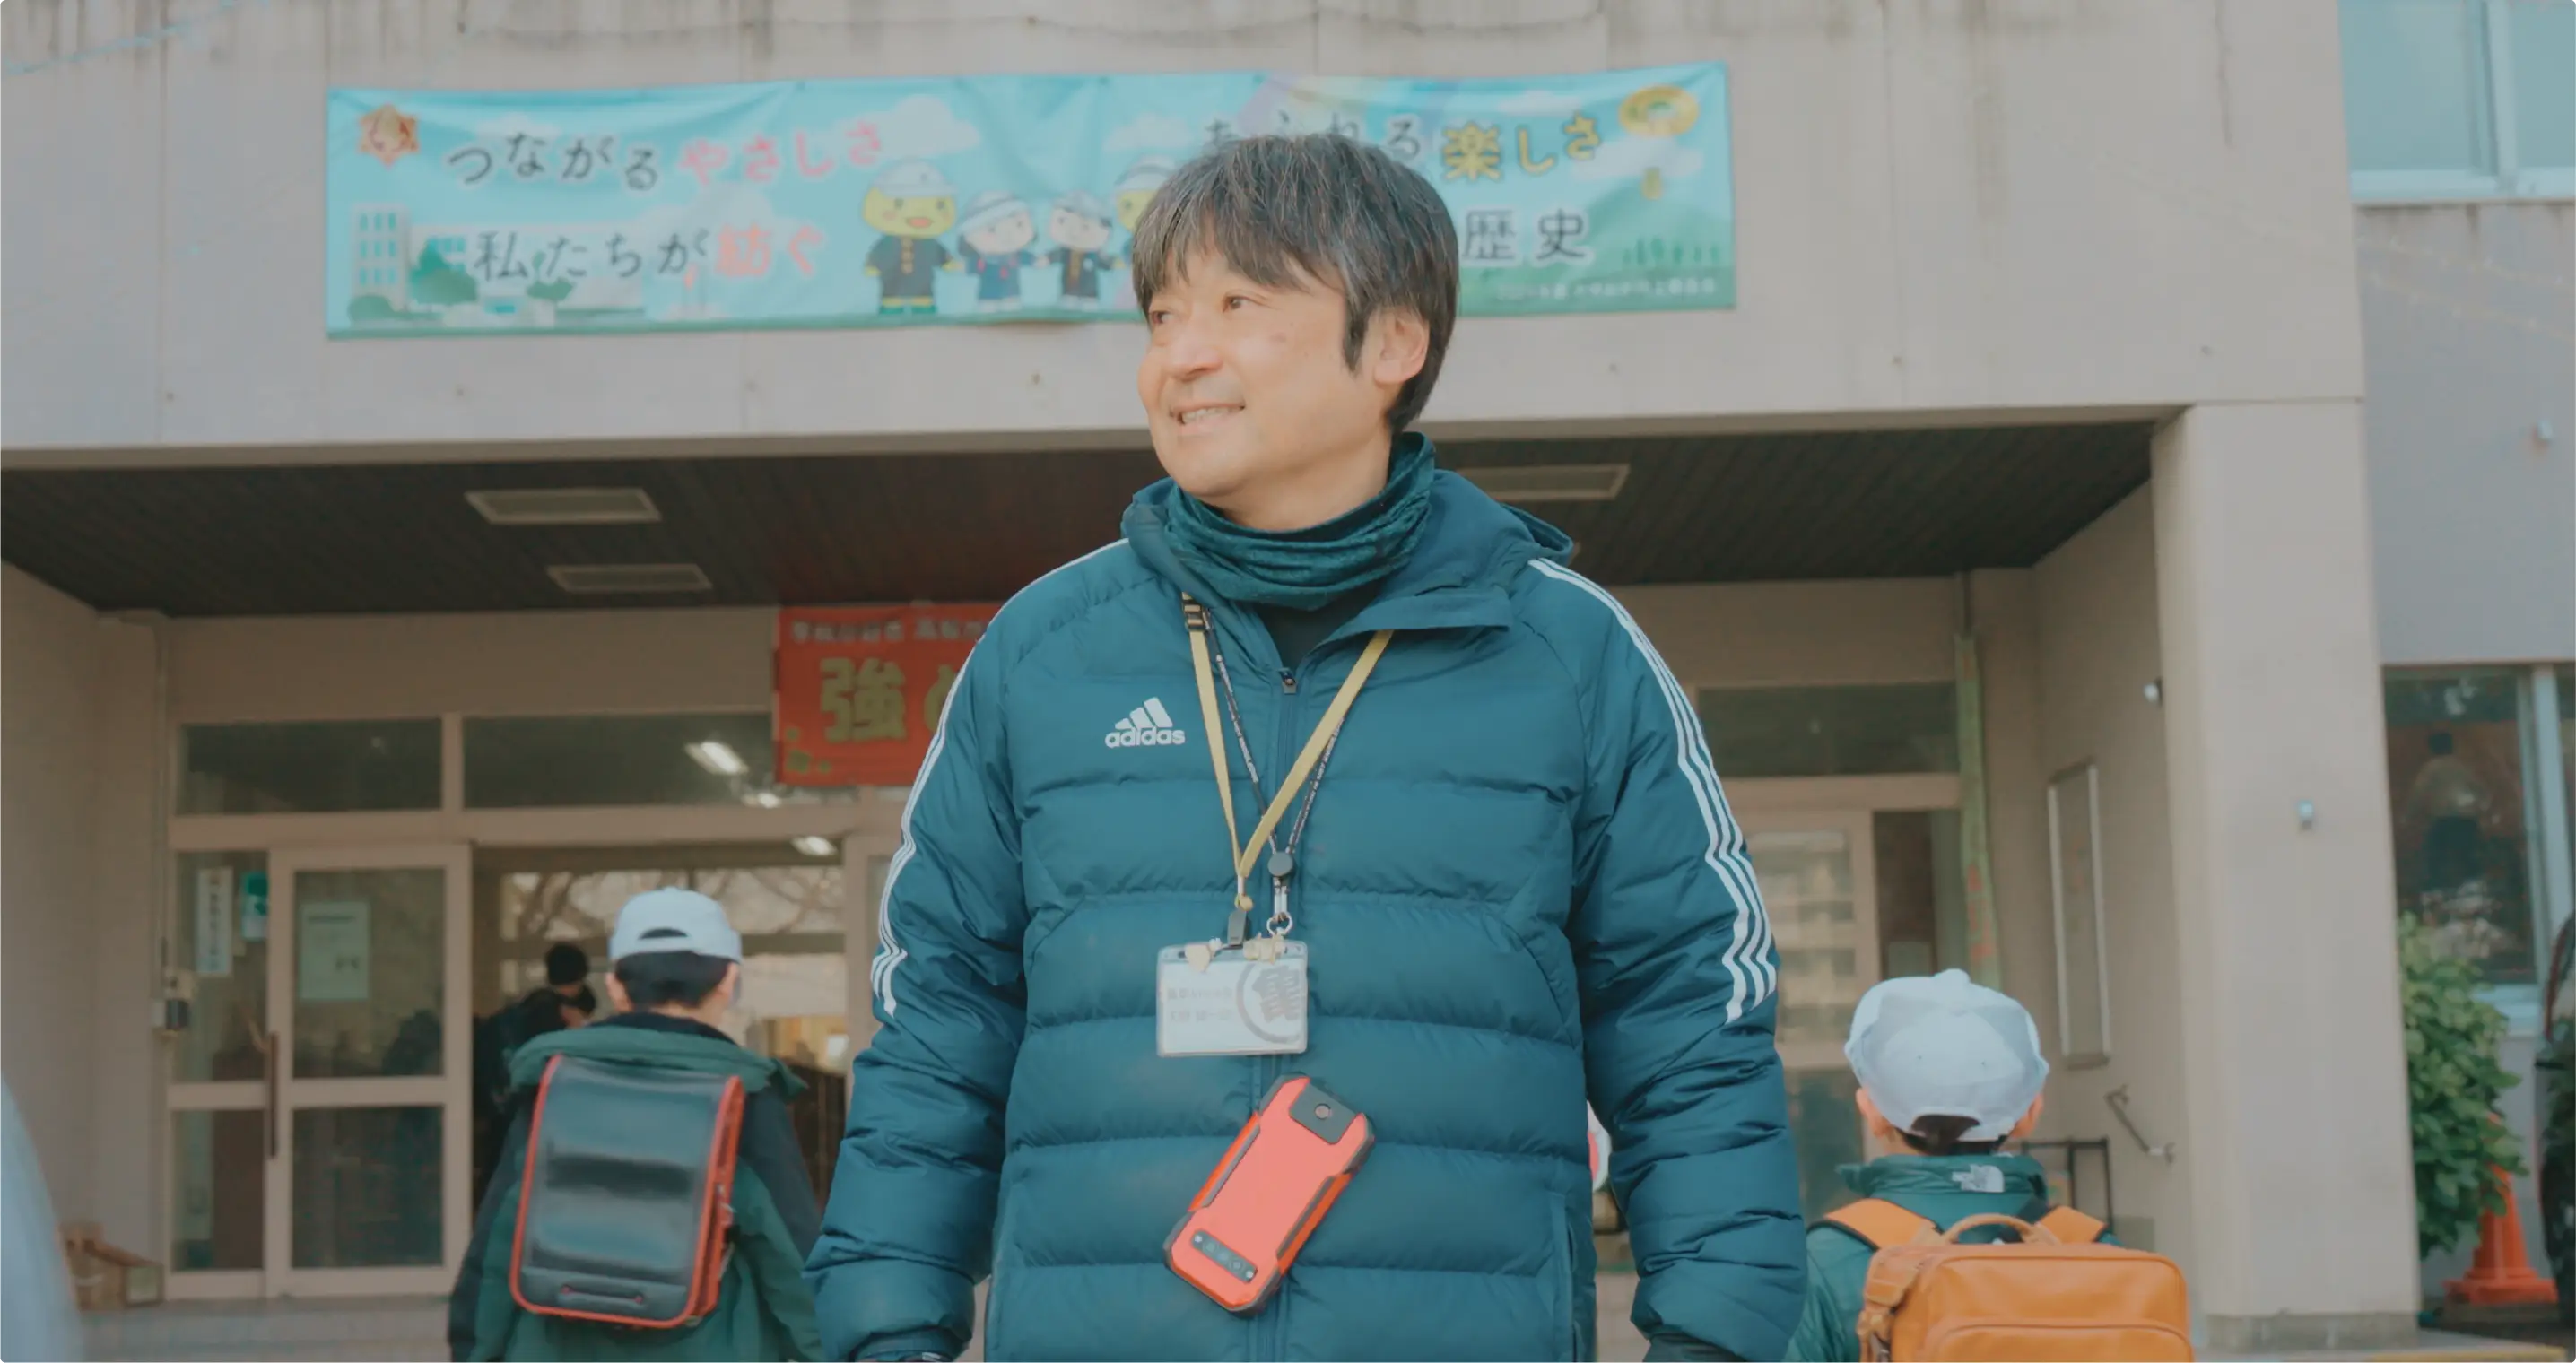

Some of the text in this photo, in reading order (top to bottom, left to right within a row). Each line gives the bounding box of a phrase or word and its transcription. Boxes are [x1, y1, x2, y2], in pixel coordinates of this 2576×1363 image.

[448, 109, 1601, 190] つながるやさしさ る楽しさ
[474, 207, 1586, 281] 私たちが紡ぐ 歴史
[1104, 725, 1186, 749] adidas
